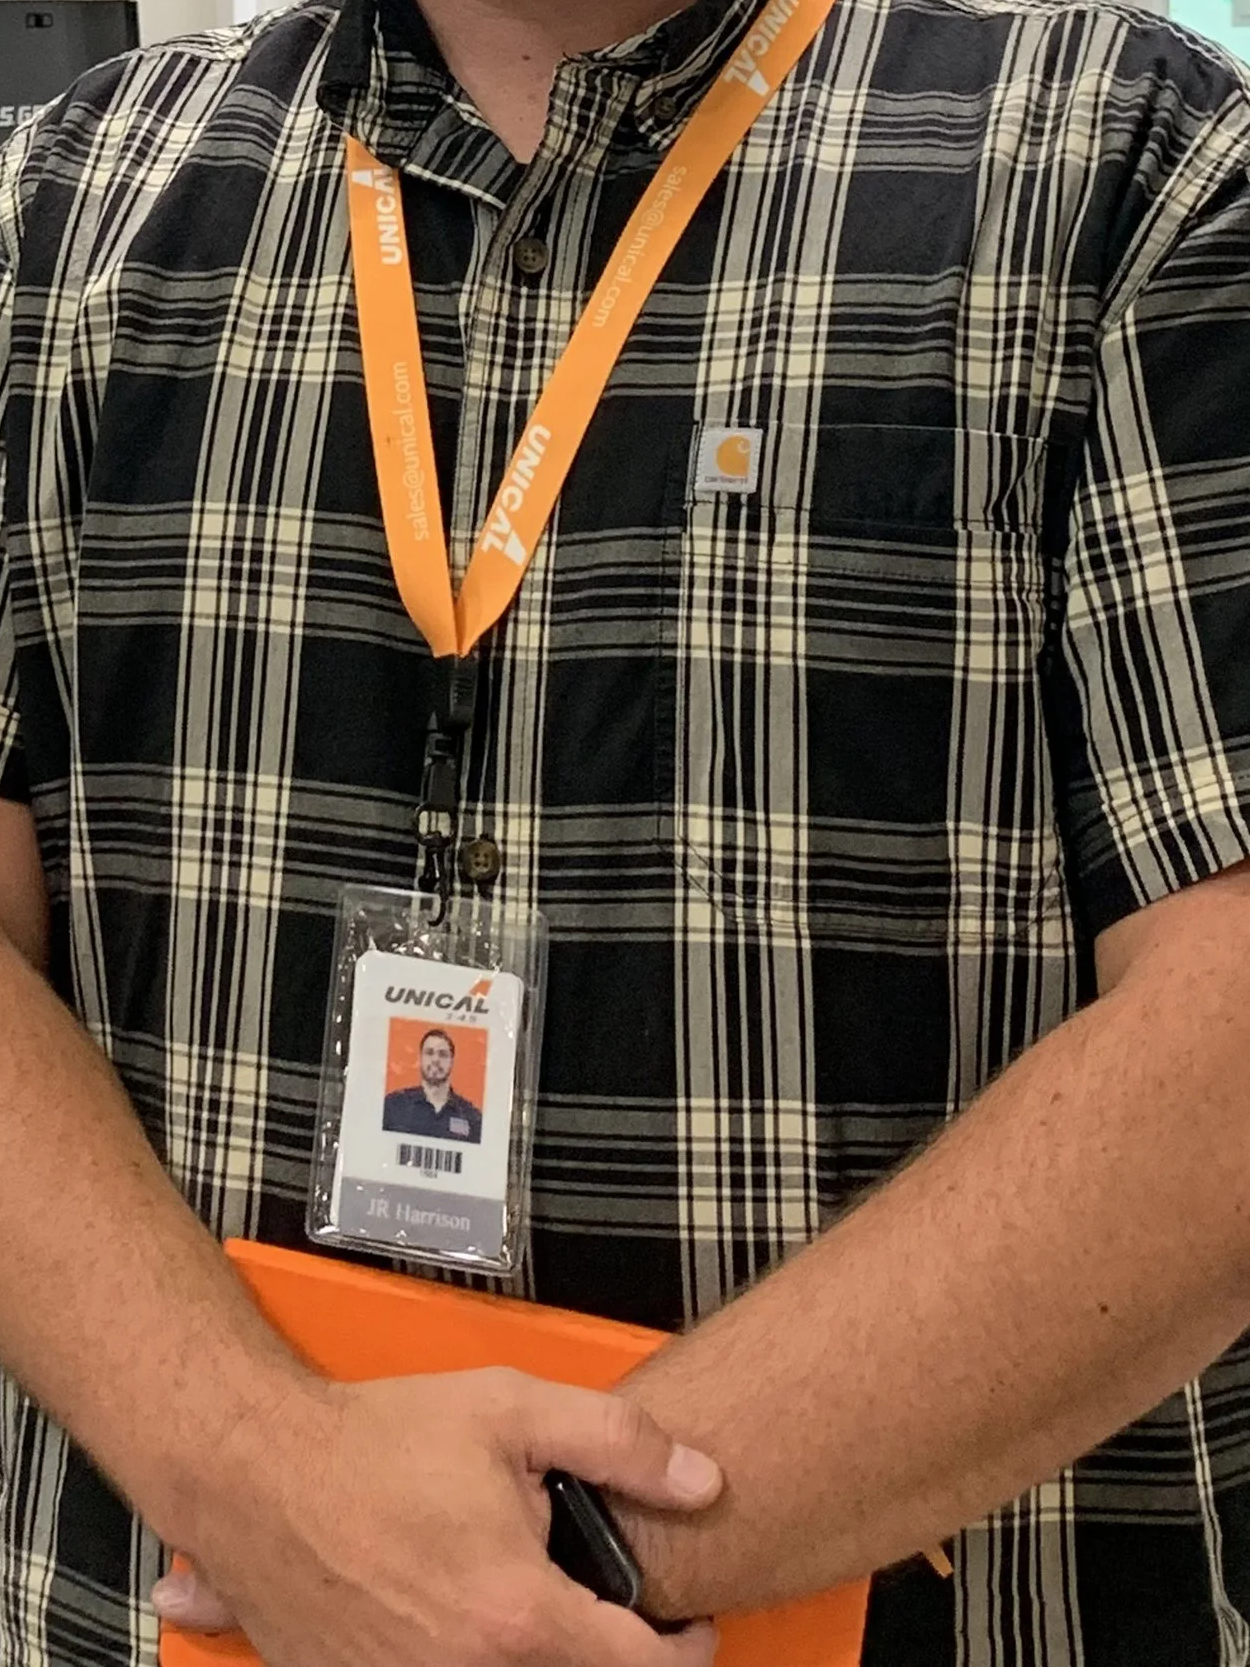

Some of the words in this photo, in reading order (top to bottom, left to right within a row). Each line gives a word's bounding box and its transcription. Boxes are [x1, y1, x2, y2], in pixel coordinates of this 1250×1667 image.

[592, 165, 688, 328] sales@unical.com
[391, 360, 429, 542] sales@unical.com
[480, 424, 552, 554] UNICAL
[384, 986, 490, 1014] UNICAL
[366, 1197, 390, 1219] JR
[395, 1202, 471, 1231] Harrison
